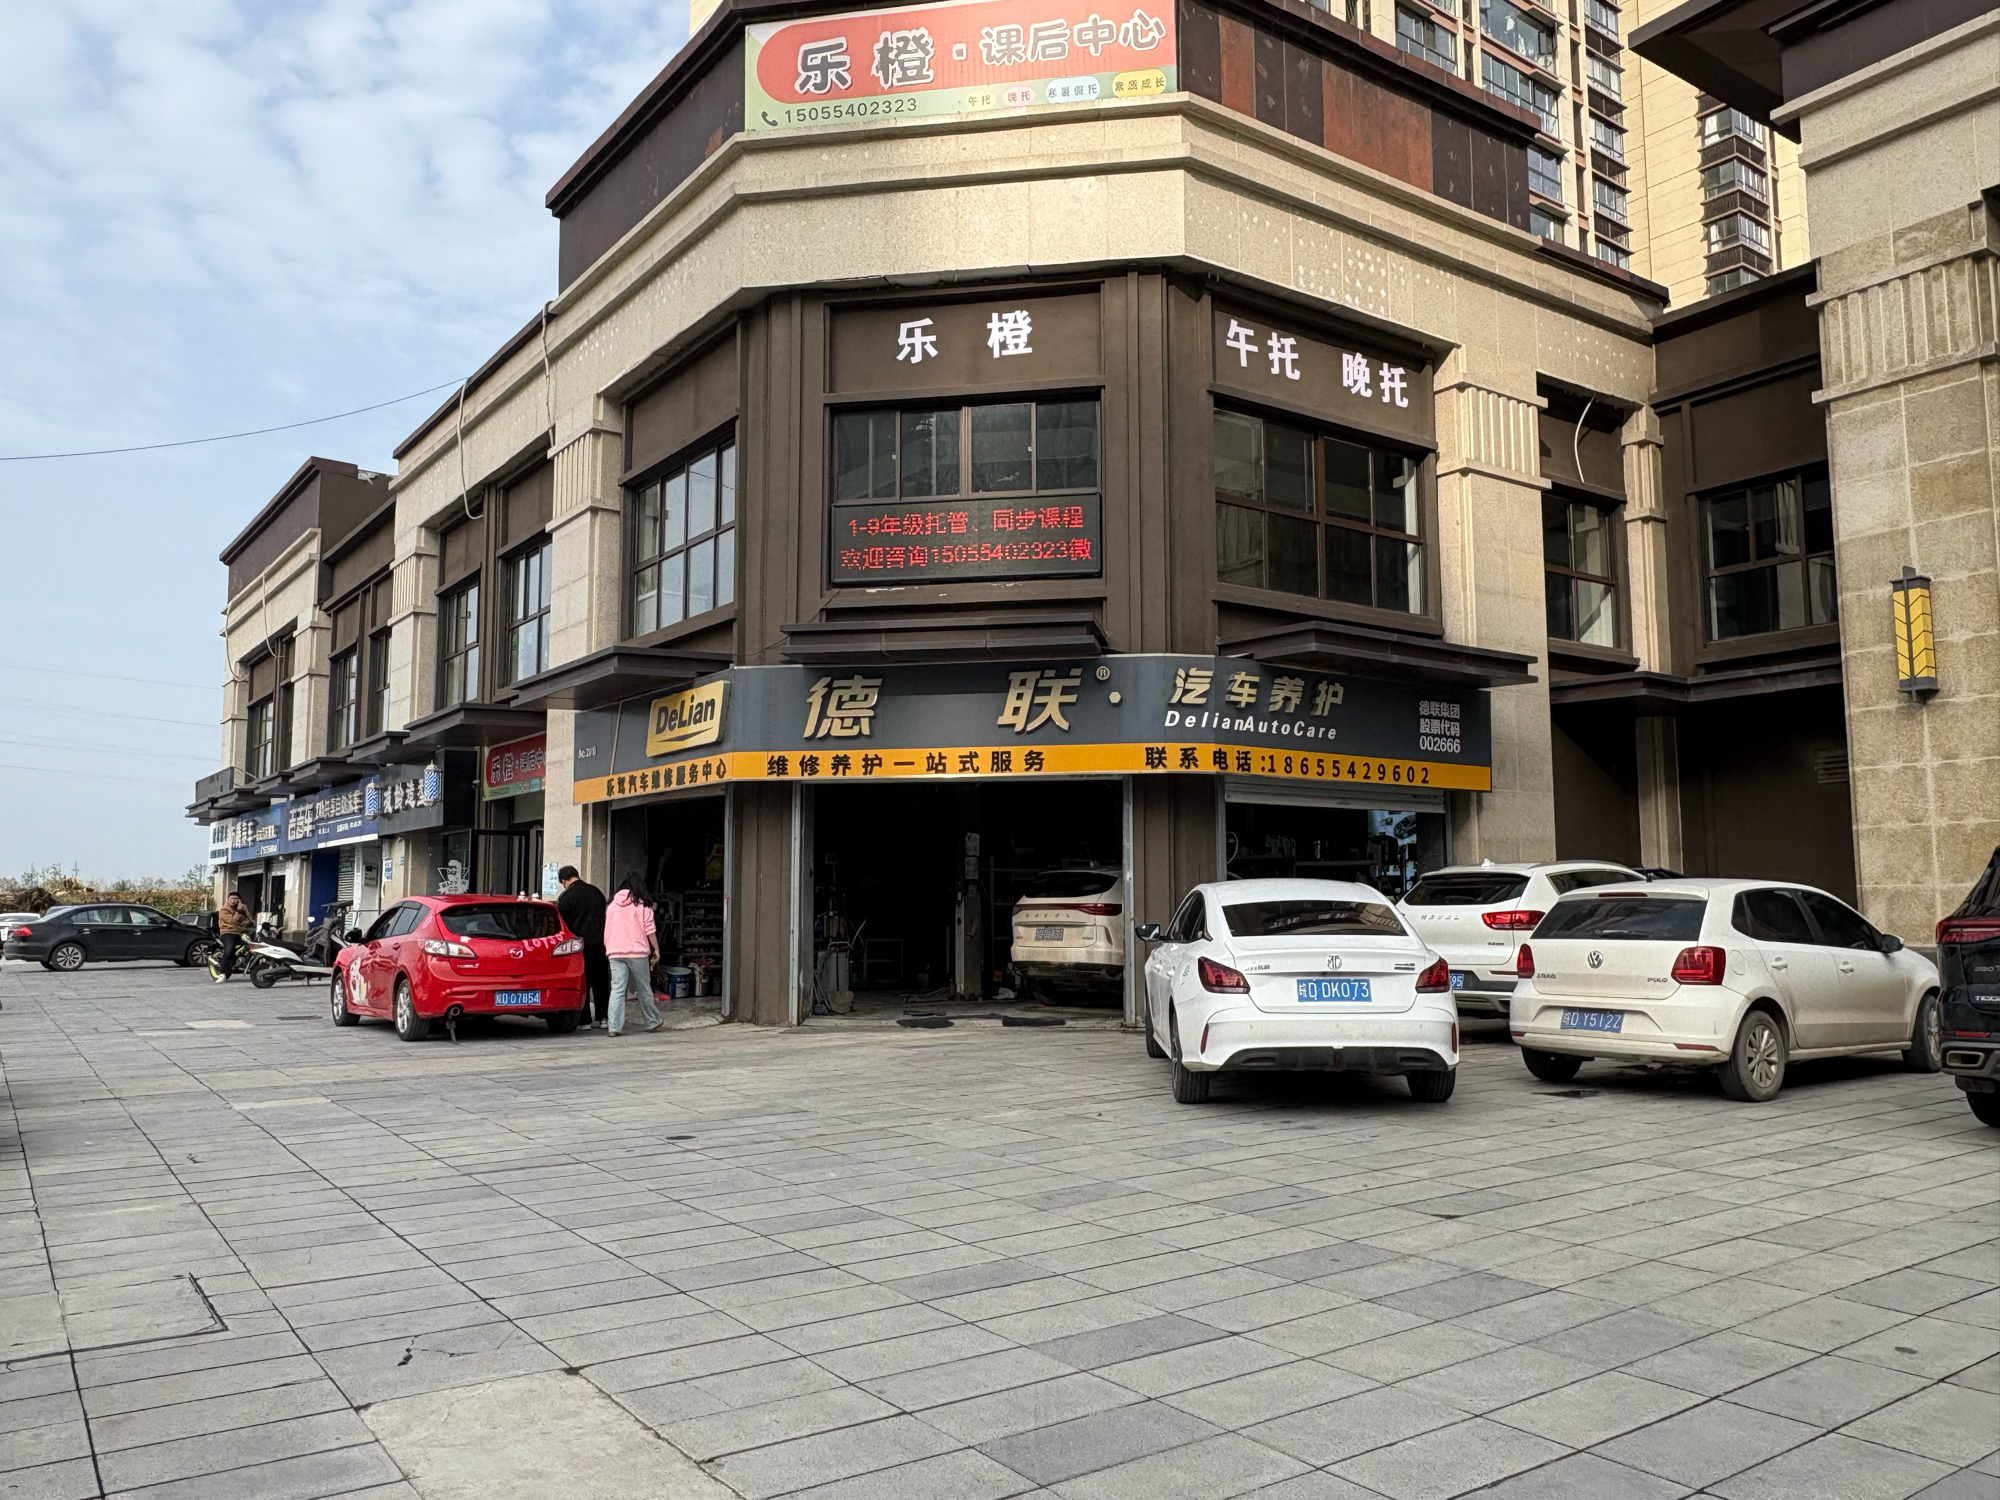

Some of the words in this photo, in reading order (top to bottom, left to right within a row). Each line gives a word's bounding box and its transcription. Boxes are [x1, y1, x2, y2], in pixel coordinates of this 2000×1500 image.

[784, 97, 918, 124] 15055402323
[1226, 319, 1300, 381] 午托
[1342, 352, 1408, 408] 晚托
[655, 697, 716, 735] DeLian
[1420, 718, 1460, 737] 股票代码
[1419, 735, 1461, 753] 002666
[767, 750, 1045, 777] 维修养护一站式服务
